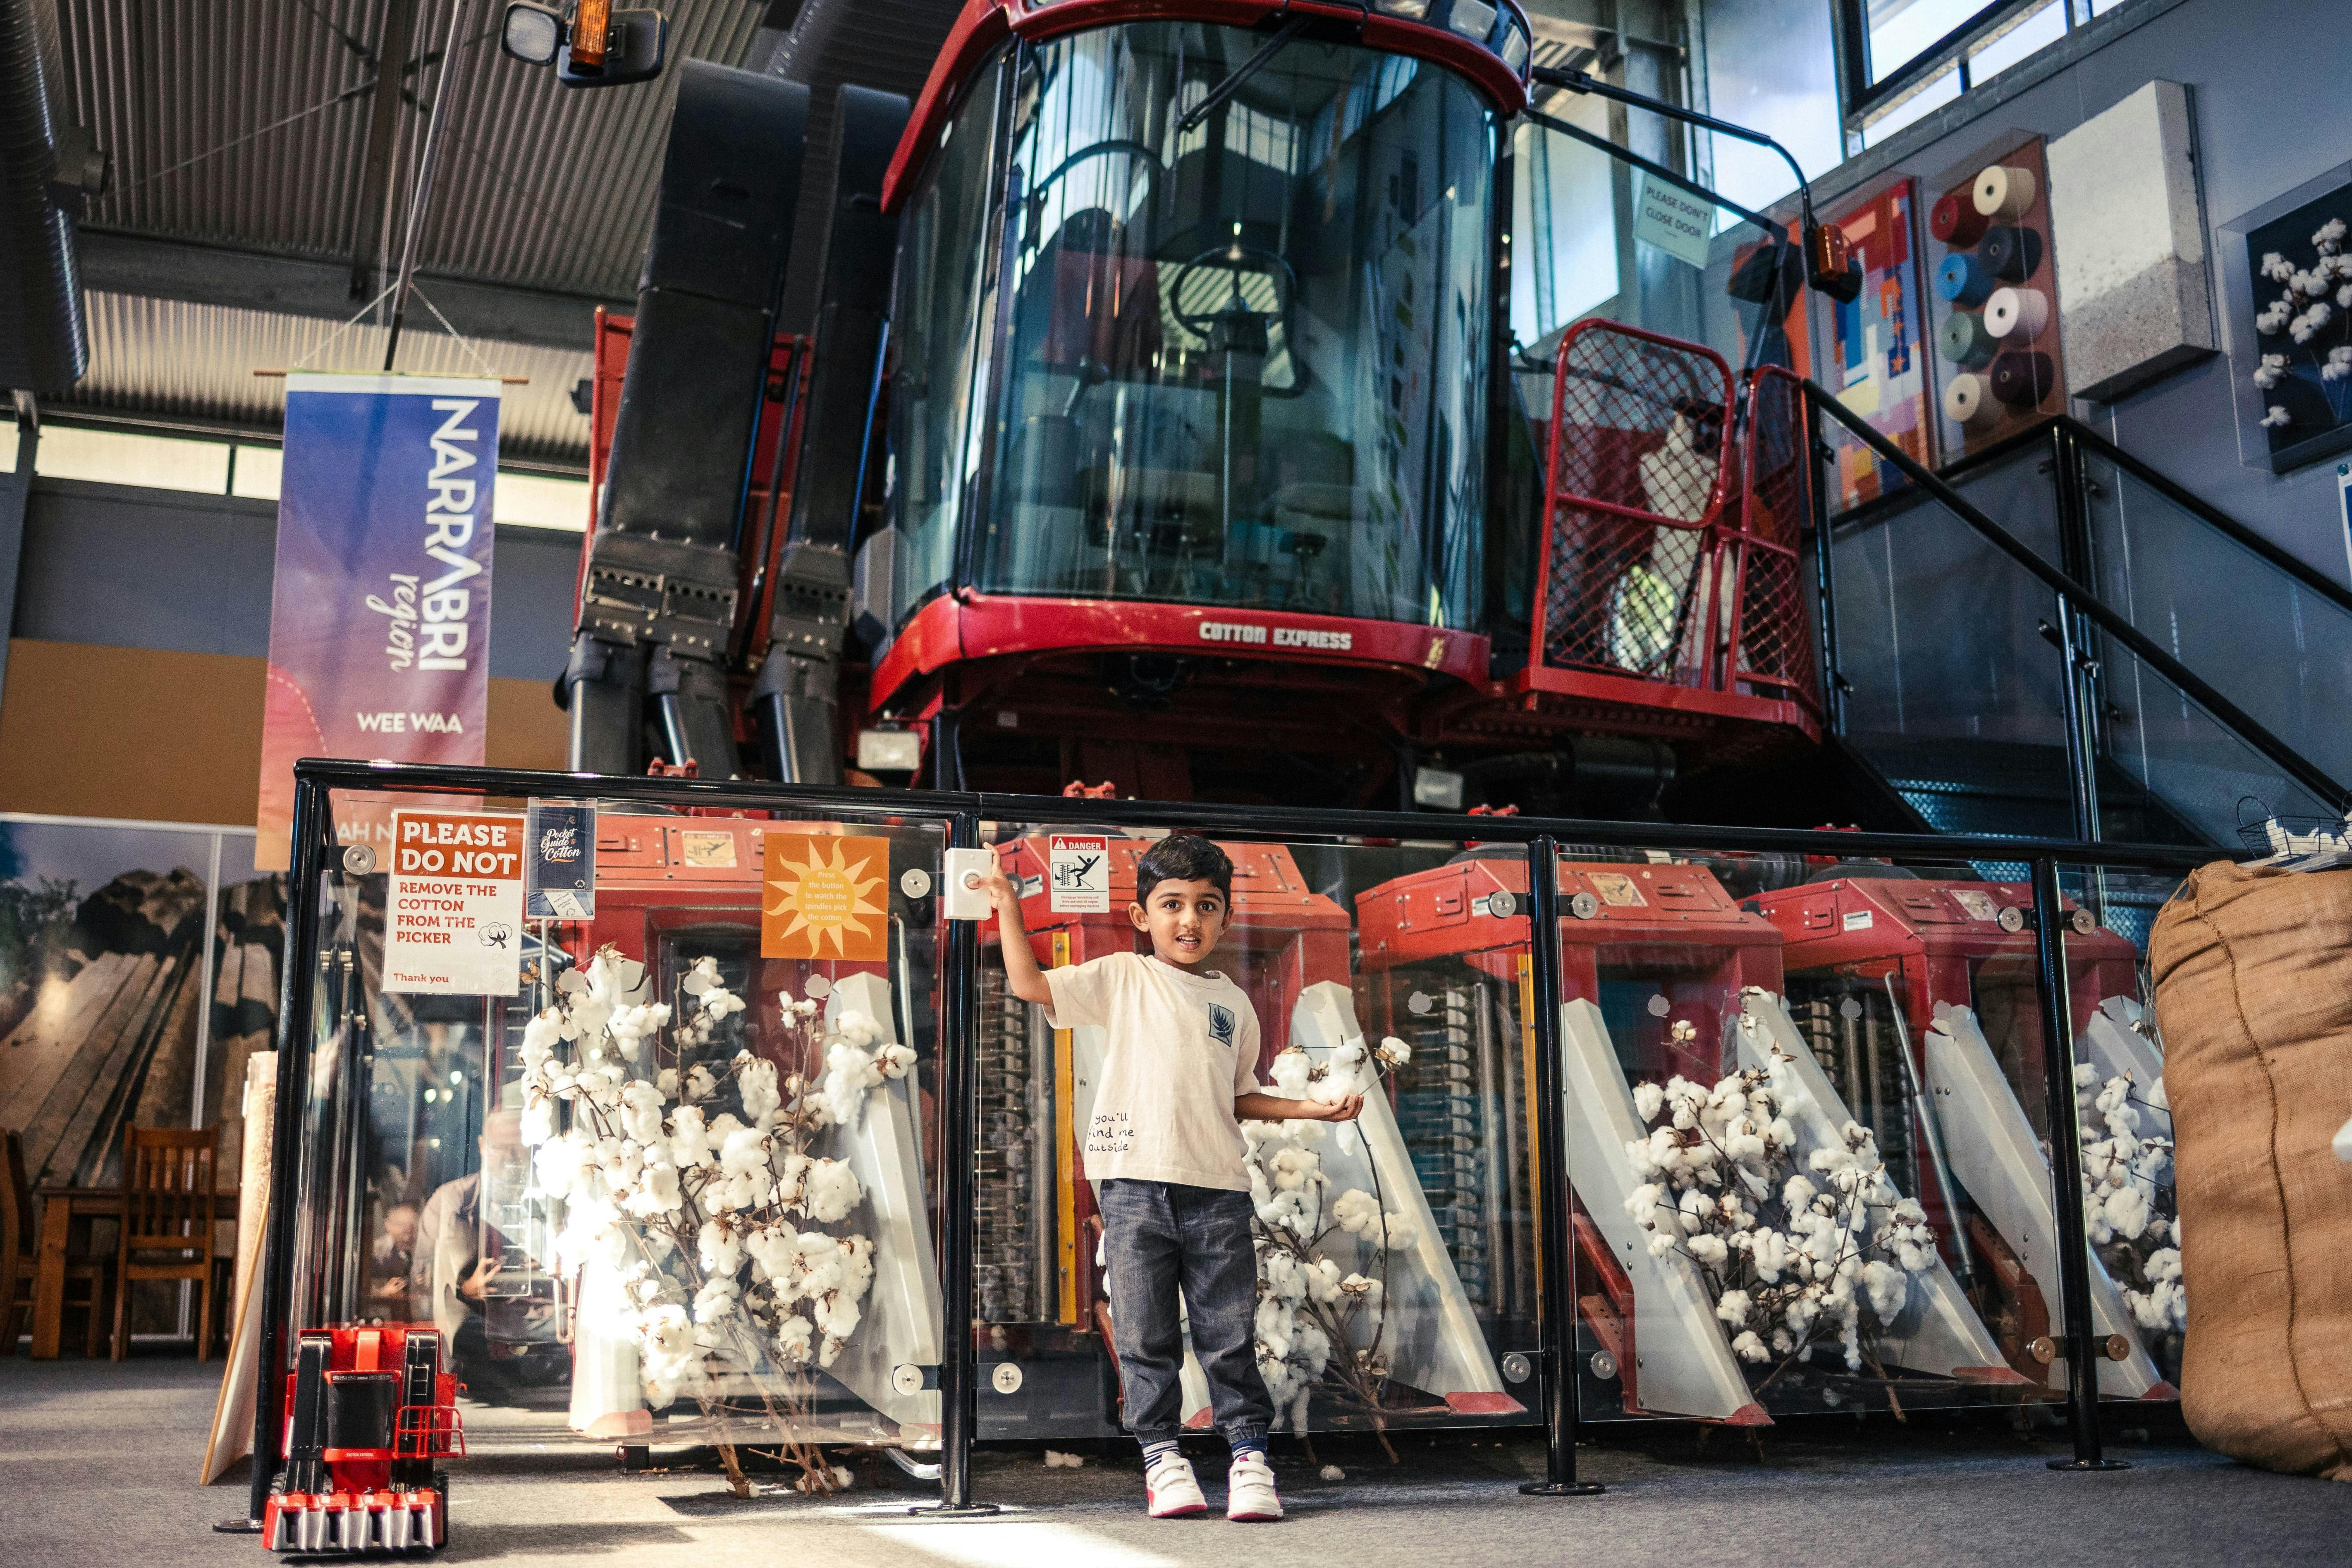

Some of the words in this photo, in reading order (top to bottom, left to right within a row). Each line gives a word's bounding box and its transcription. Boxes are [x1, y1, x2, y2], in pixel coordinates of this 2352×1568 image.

[1646, 186, 1678, 208] PLEASE
[1679, 202, 1708, 221] DON'T
[1645, 206, 1673, 227] CLOSE
[1675, 219, 1702, 238] DOOR
[419, 399, 482, 671] NARRABRI
[366, 573, 420, 673] region
[1199, 622, 1266, 644] COTTON
[1273, 627, 1351, 650] EXPRESS
[357, 713, 405, 732] WEE
[410, 713, 463, 733] WAA
[403, 821, 507, 847] PLEASE
[547, 828, 578, 839] Pocket
[540, 836, 569, 853] Guide
[401, 848, 444, 872] DO
[452, 851, 517, 874] NOT
[545, 846, 581, 861] Cotton
[400, 882, 462, 895] REMOVE
[467, 885, 497, 896] THE
[398, 898, 464, 911] COTTON
[398, 915, 440, 928] FROM
[444, 916, 475, 928] THE
[397, 931, 451, 944] PICKER
[394, 973, 427, 982] Thank
[1095, 1112, 1128, 1125] you'll
[1088, 1126, 1113, 1140] find
[1089, 1140, 1128, 1152] outside
